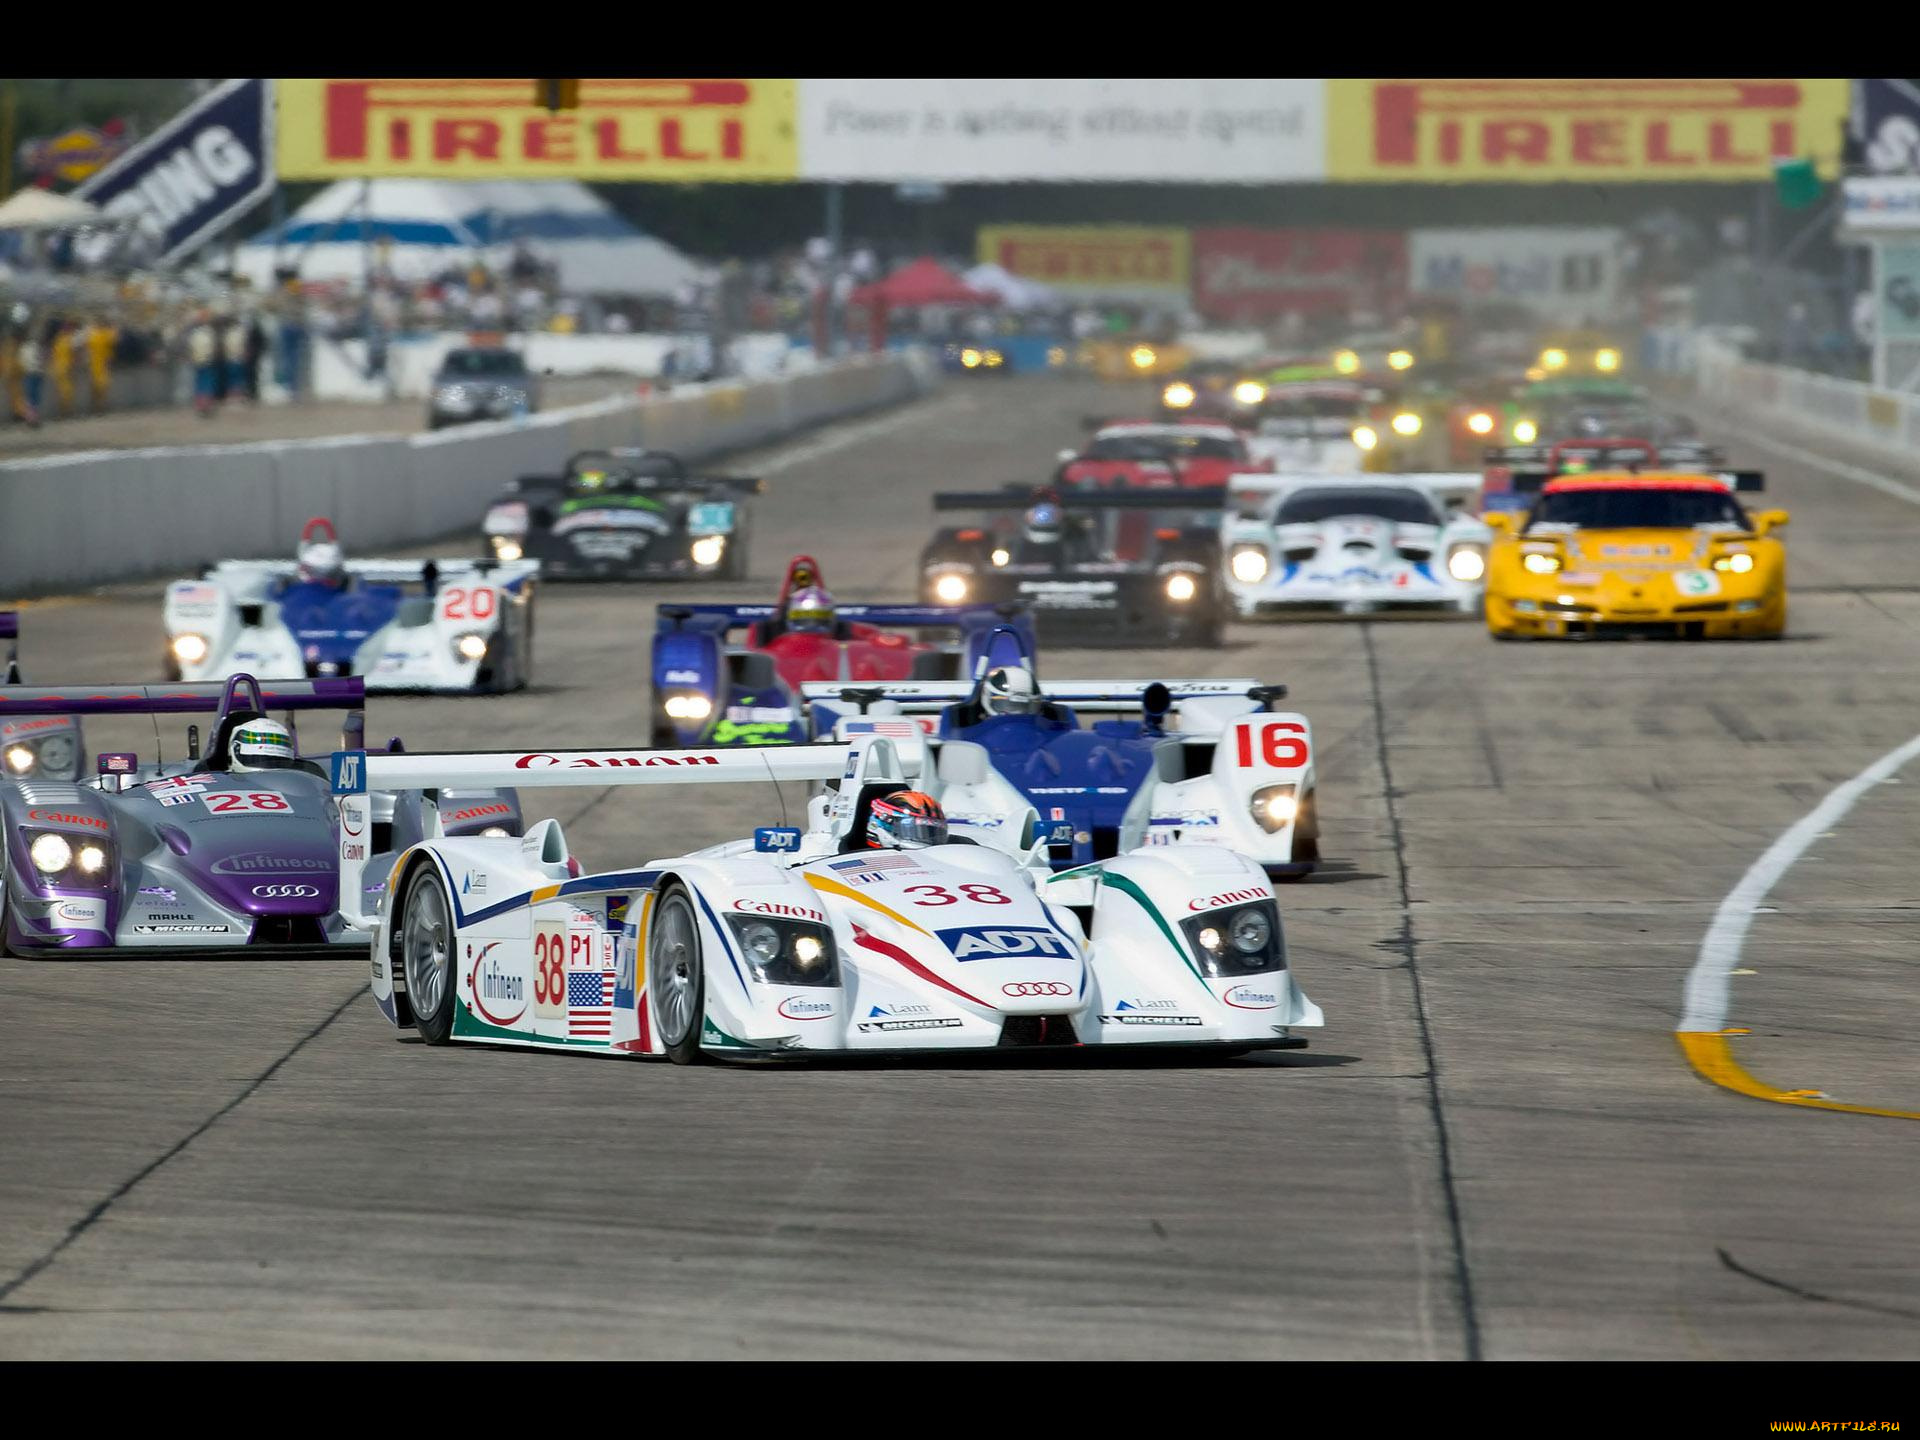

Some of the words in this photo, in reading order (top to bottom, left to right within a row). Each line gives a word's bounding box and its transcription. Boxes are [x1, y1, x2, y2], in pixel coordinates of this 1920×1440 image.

[325, 80, 750, 160] PIRELLI
[1372, 82, 1802, 165] PIRELLI
[442, 587, 497, 620] 20
[1235, 722, 1309, 768] 16
[337, 755, 360, 789] ADT
[514, 753, 720, 769] Canon
[205, 792, 289, 812] 28
[441, 802, 511, 824] Canon
[28, 809, 108, 831] Canon
[766, 831, 797, 848] ADT
[230, 852, 332, 873] Infineon
[903, 883, 1013, 907] 38
[1188, 887, 1270, 912] Canon
[65, 905, 96, 918] Infineon
[734, 898, 824, 922] Canon
[154, 925, 227, 933] MICHELIN
[571, 935, 591, 966] P1
[954, 930, 1063, 958] ADT
[483, 959, 524, 1001] Infineon
[534, 932, 565, 1006] 38
[788, 998, 833, 1014] Infineon
[1135, 998, 1174, 1008] Lam
[1235, 989, 1277, 1003] Infineon
[889, 1002, 930, 1013] Lam
[882, 1018, 961, 1031] MICHELIN
[1121, 1016, 1201, 1026] MICHELIN
